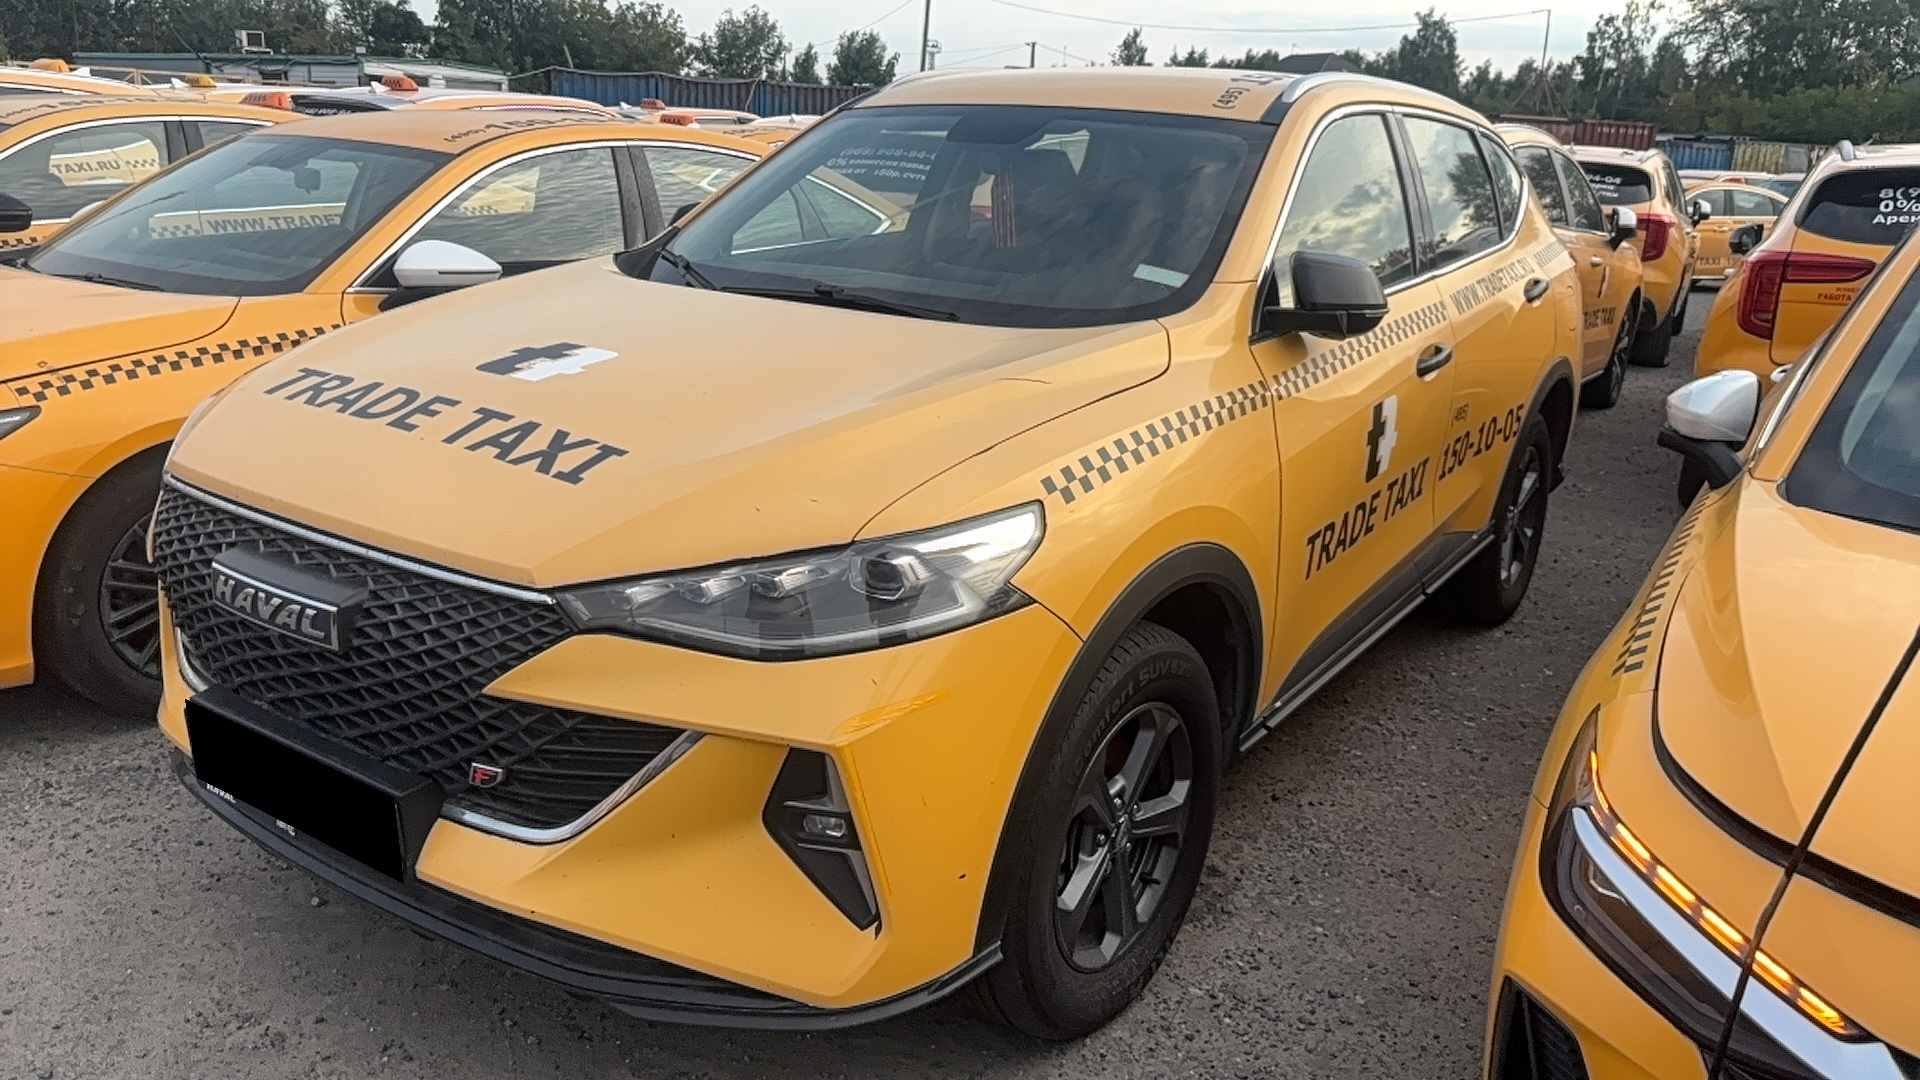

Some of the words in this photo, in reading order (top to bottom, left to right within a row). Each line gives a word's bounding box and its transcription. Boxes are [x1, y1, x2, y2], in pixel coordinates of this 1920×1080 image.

[51, 160, 121, 175] TAXI.RU
[263, 367, 463, 433] TRADE
[441, 407, 630, 486] TAXI
[1438, 403, 1525, 482] 150-10-05
[1305, 489, 1382, 581] TRADE
[1383, 456, 1430, 523] TAXI
[216, 574, 326, 640] HAVAL
